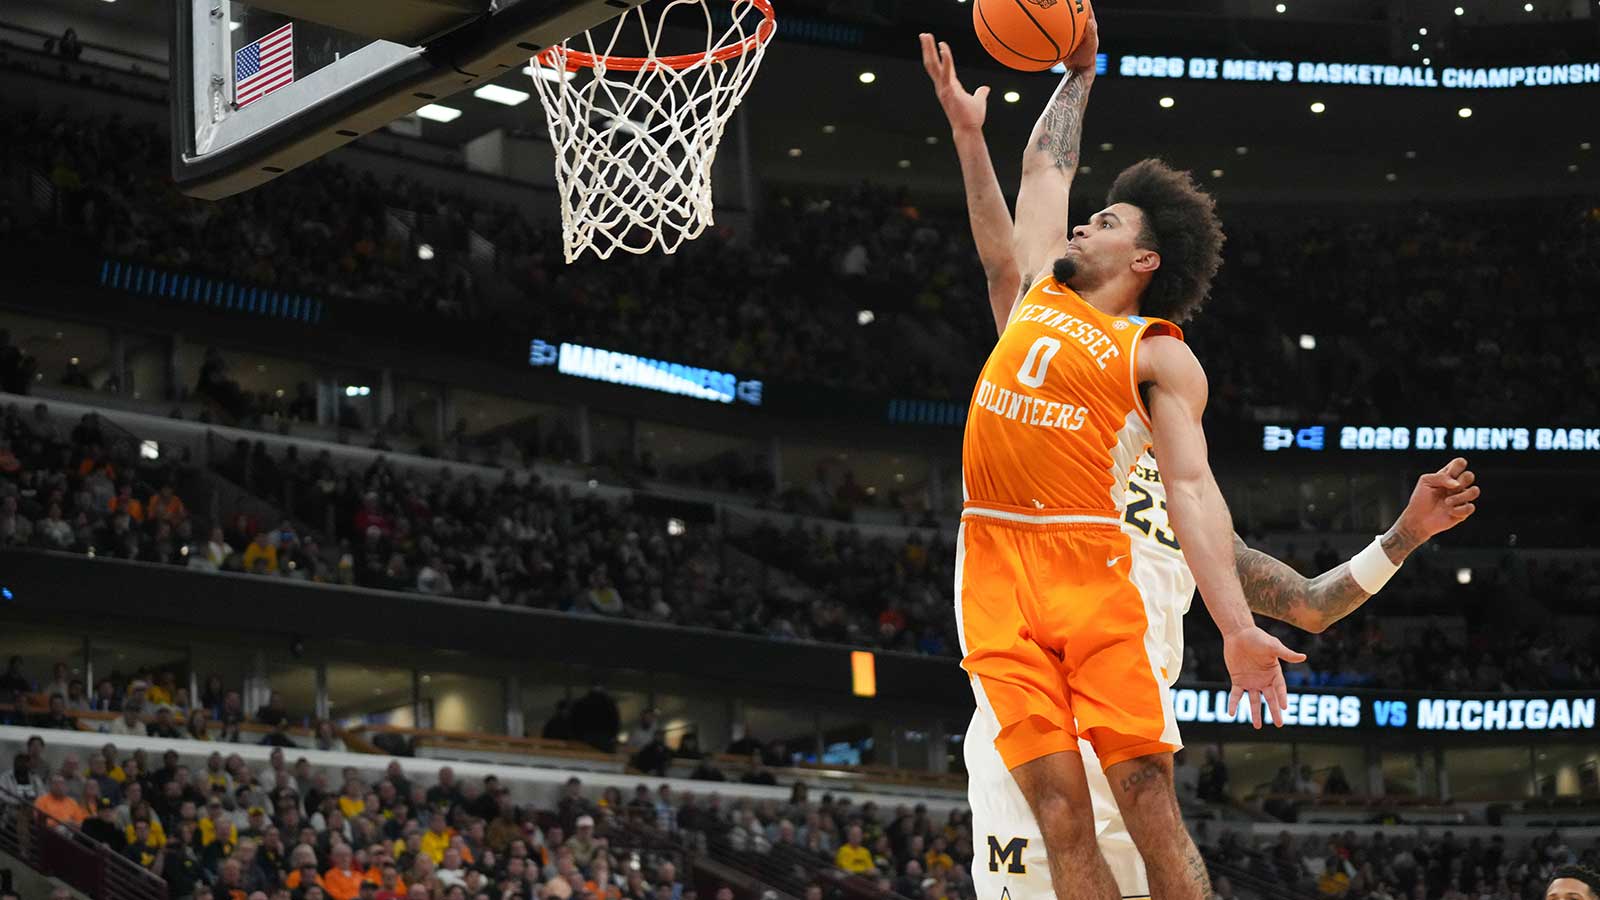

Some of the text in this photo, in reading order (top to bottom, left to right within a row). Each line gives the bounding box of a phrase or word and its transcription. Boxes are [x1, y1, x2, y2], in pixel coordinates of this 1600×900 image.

[1120, 55, 1600, 89] 2026 DI MEN'S BASKETBALL CHAMPIONSH
[1016, 336, 1062, 389] 0
[975, 379, 1089, 431] OLUNTEERS
[1340, 426, 1410, 450] 2026
[1415, 427, 1448, 450] DI
[1452, 427, 1530, 450] MEN'S
[1169, 688, 1596, 731] OLUNEERS VS MICHIGAN
[987, 835, 1029, 874] M
